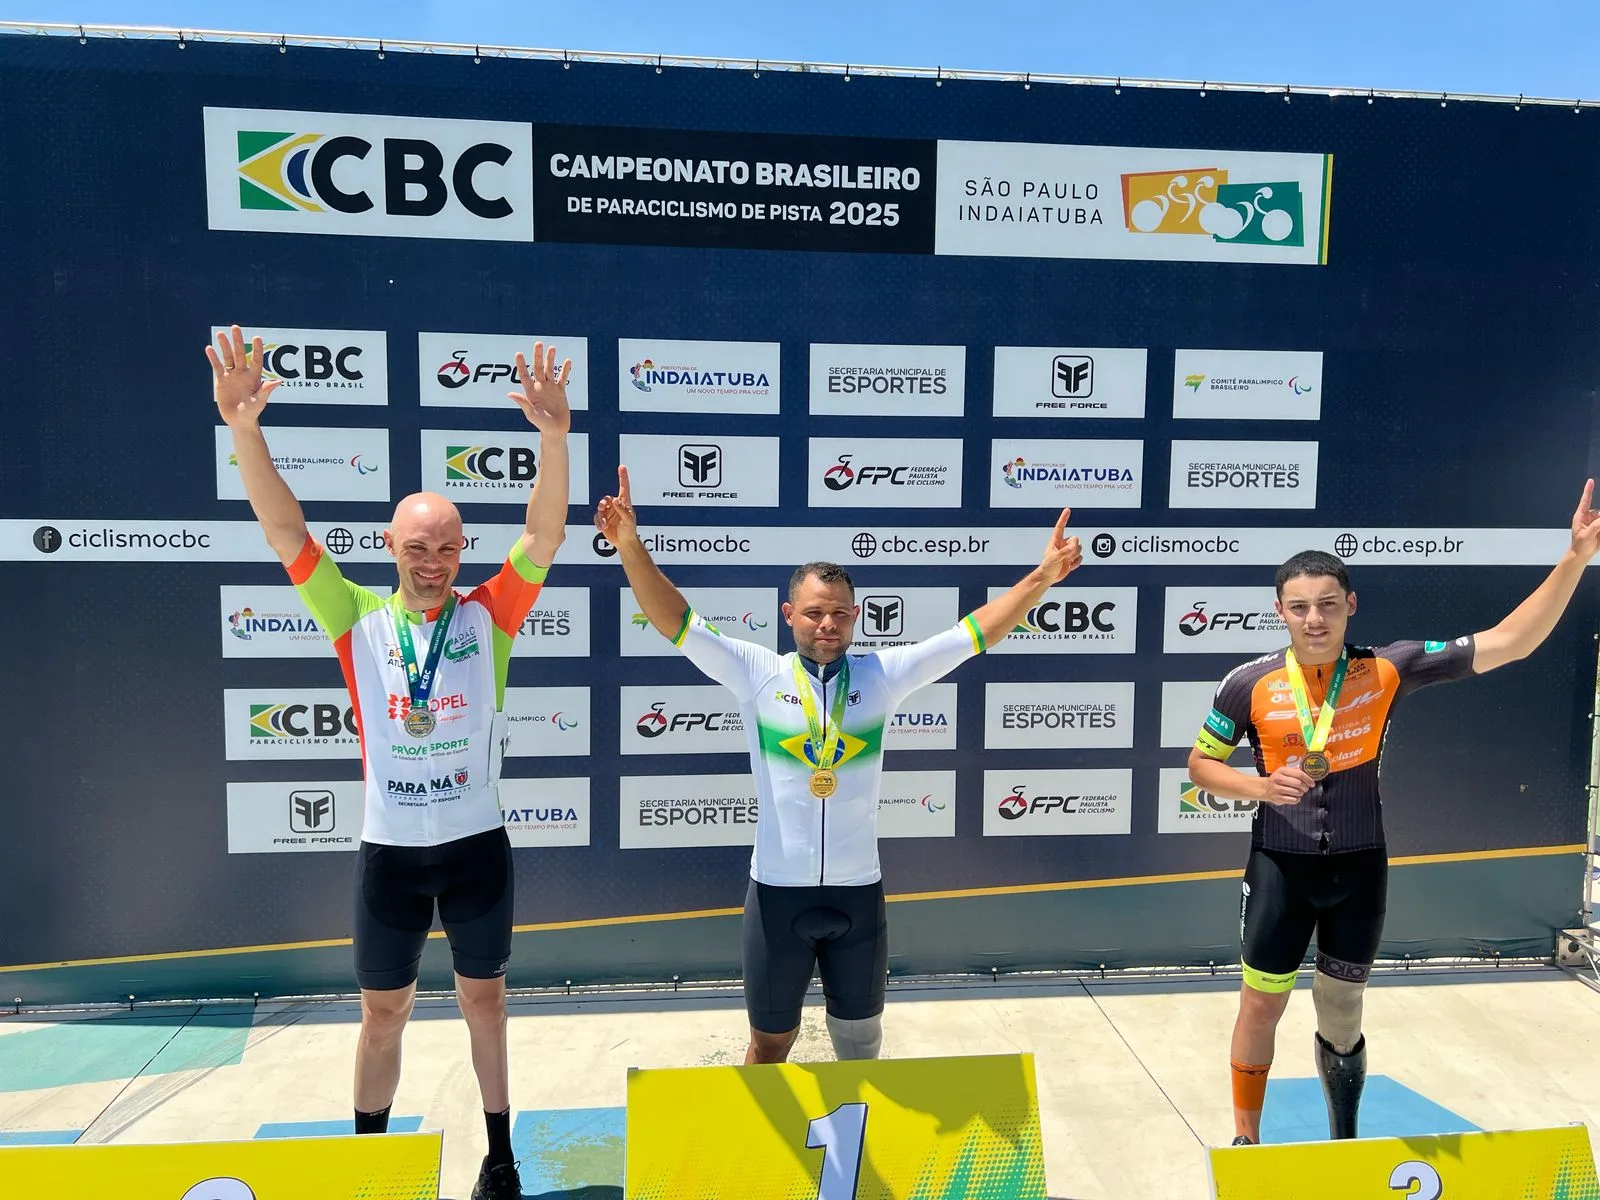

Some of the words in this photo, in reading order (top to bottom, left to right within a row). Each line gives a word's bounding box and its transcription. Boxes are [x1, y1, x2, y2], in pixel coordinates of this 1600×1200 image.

[311, 136, 514, 219] CBC
[550, 153, 749, 185] CAMPEONATO
[756, 162, 920, 191] BRASILEIRO
[964, 174, 1011, 199] SÃO
[1023, 182, 1098, 200] PAULO
[567, 196, 592, 213] DE
[597, 198, 737, 219] PARACICLISMO
[742, 203, 765, 219] DE
[770, 204, 823, 221] PISTA
[829, 201, 899, 226] 2025
[959, 205, 1103, 225] INDAIATUBA
[272, 345, 364, 380] CBC
[829, 367, 884, 375] SECRETARIA
[885, 368, 933, 376] MUNICIPAL
[934, 368, 946, 376] DE
[646, 371, 769, 387] INDAIATUBA
[828, 375, 947, 394] ESPORTES
[477, 447, 538, 481] CB
[1188, 462, 1241, 471] SECRETARIA
[1242, 463, 1287, 471] MUNICIPAL
[1288, 463, 1300, 471] DE
[856, 466, 909, 485] FPC
[910, 465, 947, 473] FEDERAÇÃO
[1017, 468, 1133, 481] INDAIATUBA
[1187, 471, 1299, 488] ESPORTES
[446, 481, 523, 489] PARACICLISMO
[69, 529, 210, 548] ciclismocbc
[637, 535, 750, 552] clismocbc
[882, 535, 990, 557] cbc.esp.br
[1122, 535, 1239, 553] ciclismocbc
[1362, 536, 1464, 557] cbc.esp.br
[527, 610, 555, 618] CIPAL
[557, 610, 570, 618] DE
[1037, 602, 1115, 632] CBC
[1210, 612, 1259, 630] FPC
[246, 619, 318, 632] INDAIA
[430, 694, 468, 712] OPEL
[1003, 704, 1056, 712] SECRETARIA
[670, 713, 724, 731] FPC
[1003, 712, 1116, 729] ESPORTES
[1327, 723, 1371, 743] ntos
[388, 775, 453, 794] PARANÁ
[639, 799, 697, 808] SECRETARIA
[698, 798, 747, 806] MUNICIPAL
[1029, 796, 1080, 814] FPC
[640, 806, 758, 826] ESPORTES
[806, 1103, 868, 1200] 1
